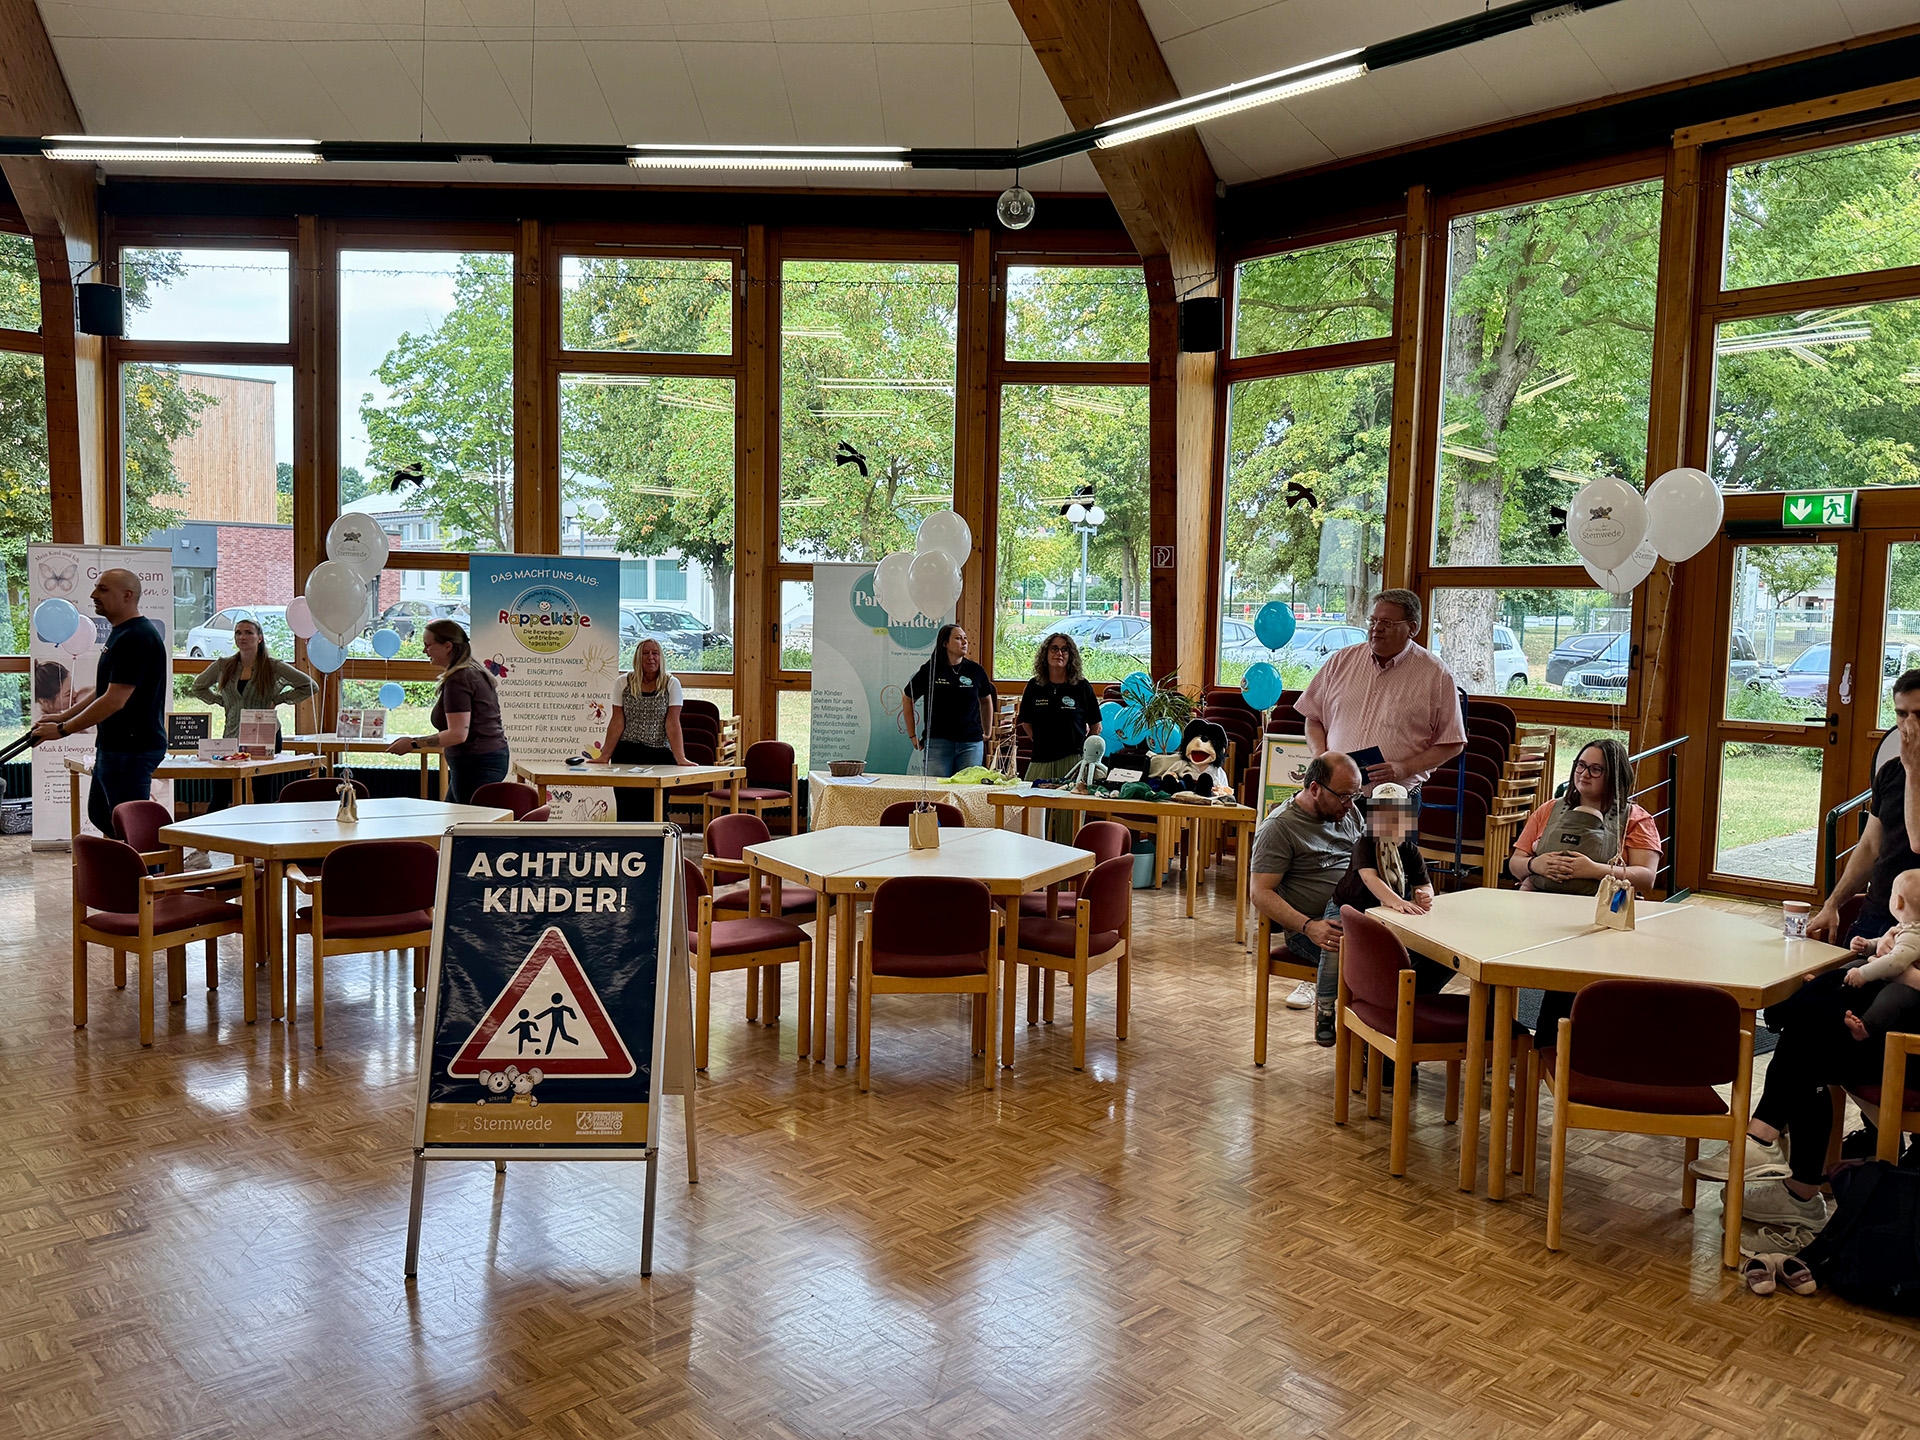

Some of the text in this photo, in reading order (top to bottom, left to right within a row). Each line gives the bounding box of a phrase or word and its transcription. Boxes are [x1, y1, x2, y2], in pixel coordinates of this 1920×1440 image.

[1582, 530, 1622, 539] Stemwede
[490, 569, 600, 587] DAS MACHT UNS AUS:
[498, 610, 591, 628] Rappelkiste
[544, 680, 588, 688] RAUMANGEBOT
[586, 692, 612, 700] MONATE
[535, 724, 548, 732] FÜR
[540, 736, 580, 744] ATMOSPHÄRE
[467, 852, 646, 878] ACHTUNG
[482, 887, 628, 914] KINDER!
[473, 1116, 553, 1132] Stemwede
